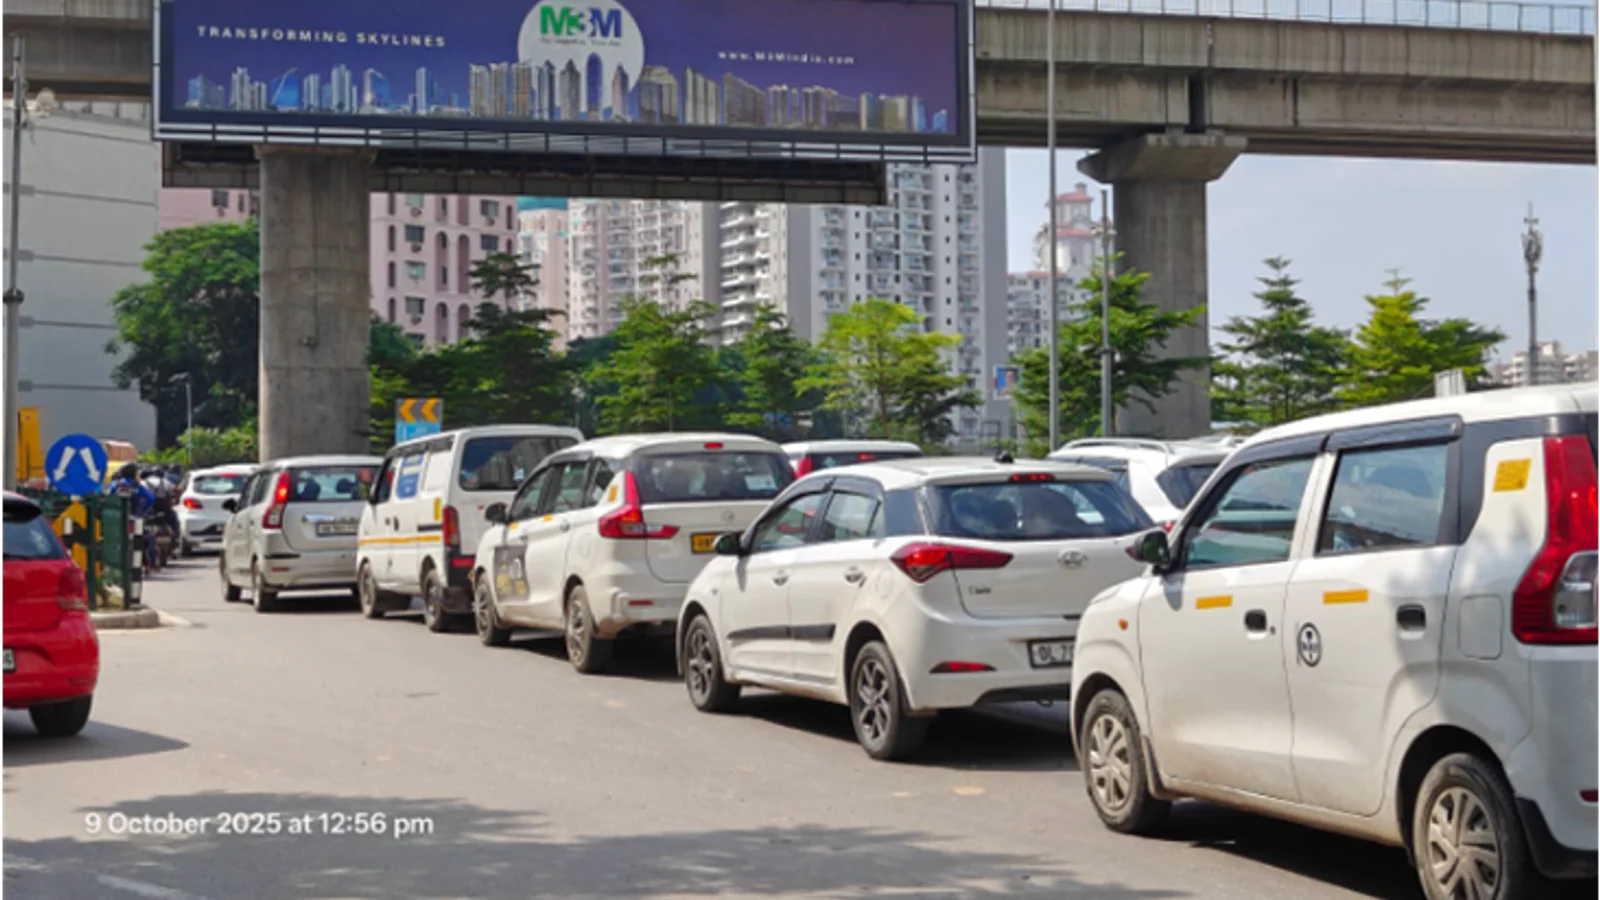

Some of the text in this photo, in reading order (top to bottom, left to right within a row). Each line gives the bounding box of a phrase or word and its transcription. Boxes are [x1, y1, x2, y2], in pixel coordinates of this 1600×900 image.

[540, 5, 622, 38] M3M
[197, 25, 446, 47] TRANSFORMING SKYLINES
